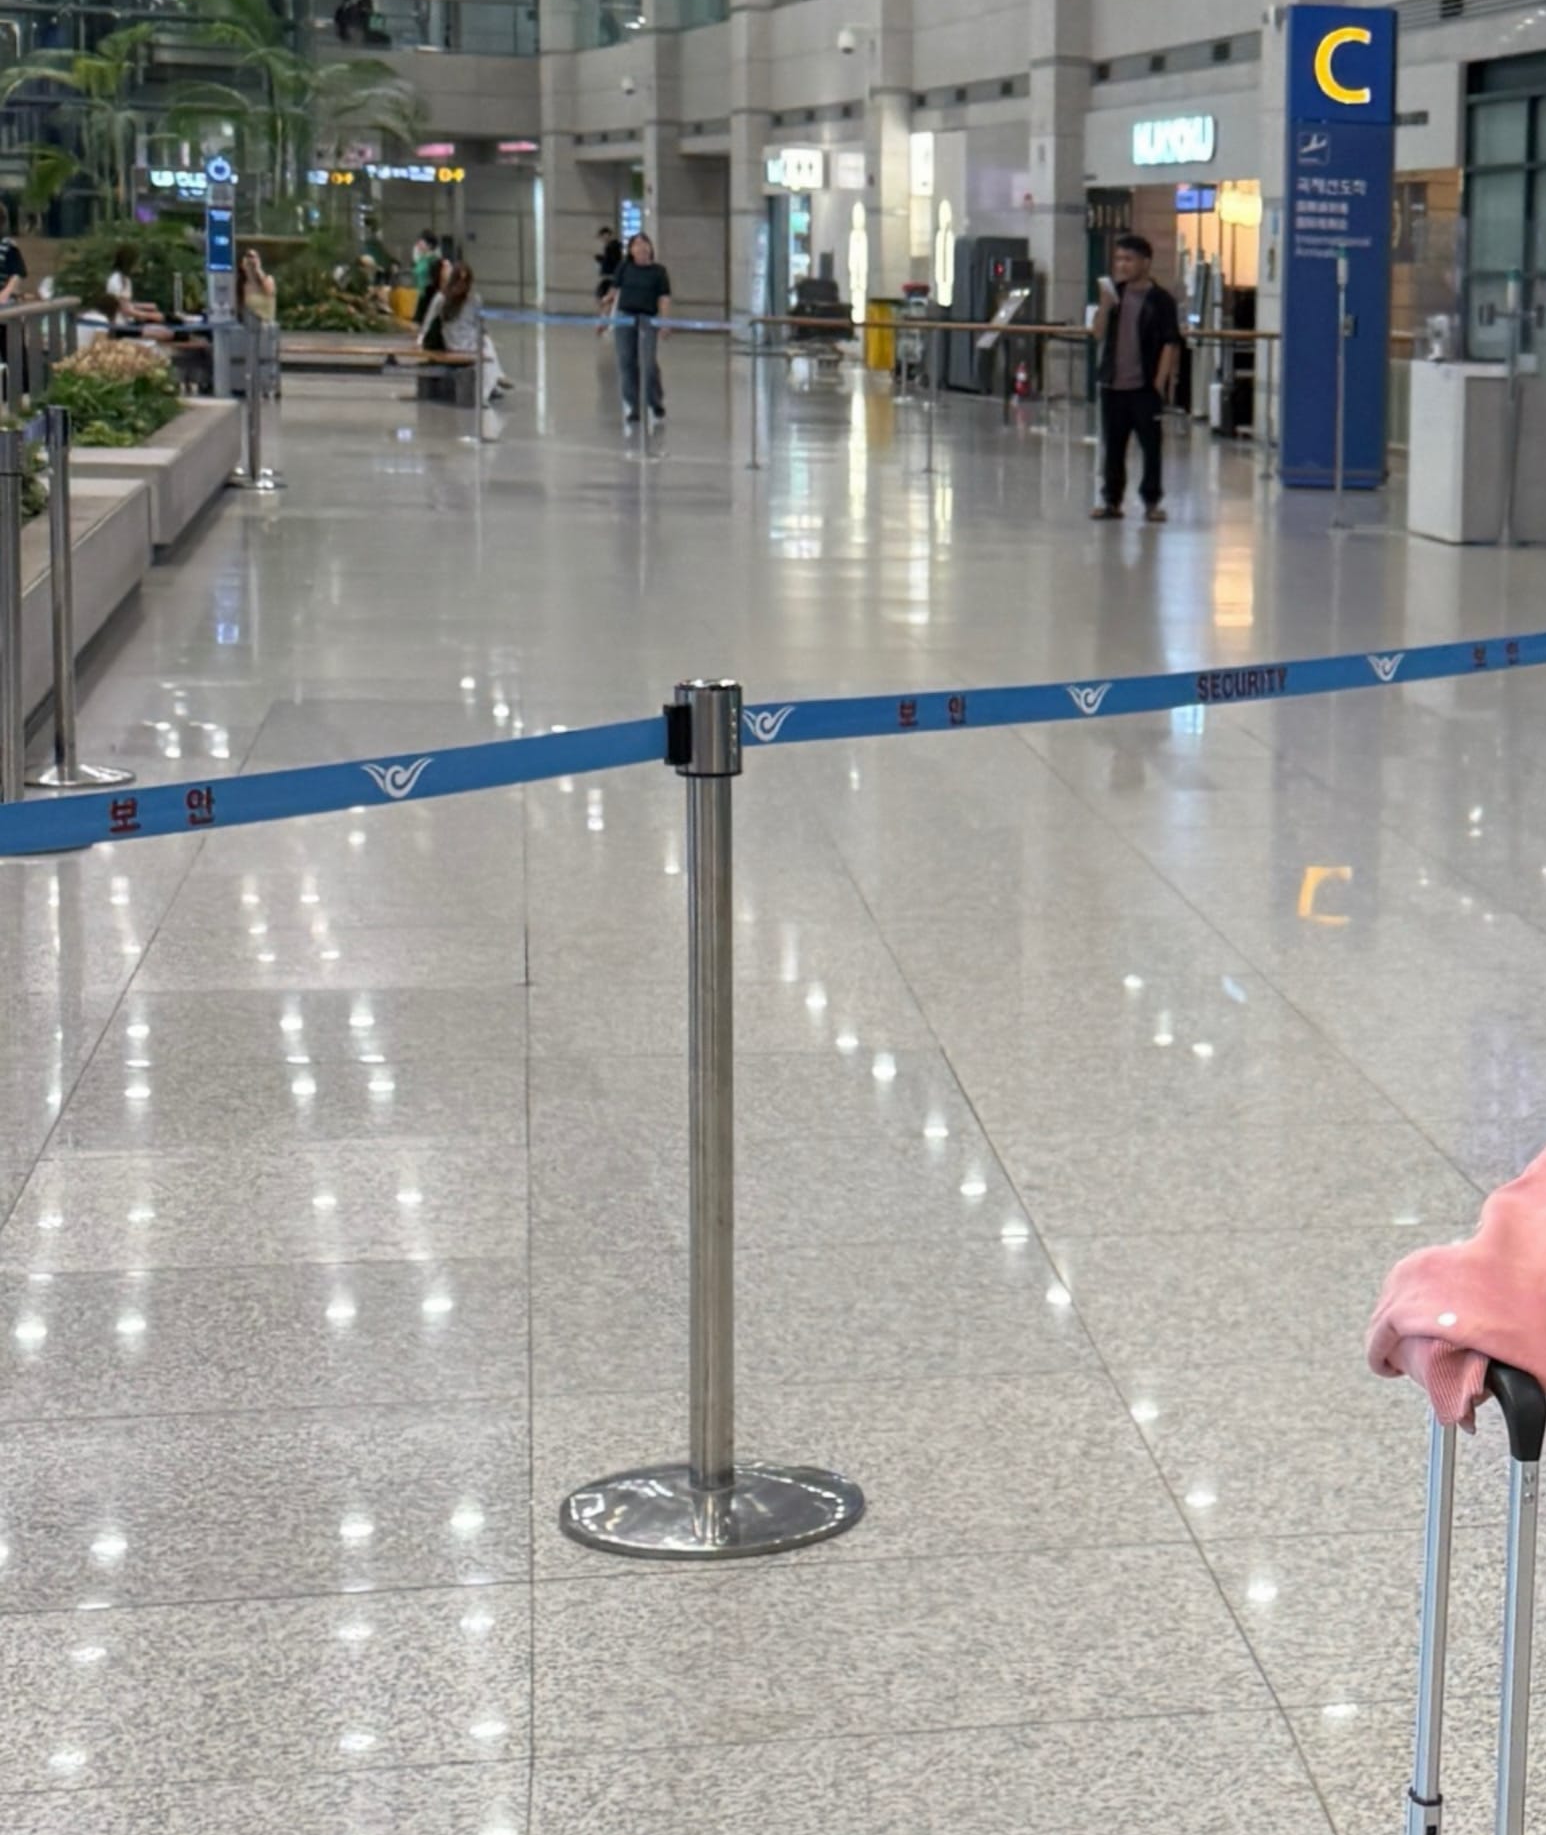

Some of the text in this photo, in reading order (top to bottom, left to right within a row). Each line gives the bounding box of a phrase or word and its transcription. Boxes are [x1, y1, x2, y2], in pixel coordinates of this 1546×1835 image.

[1314, 26, 1372, 105] C
[1197, 666, 1287, 701] SECURITY
[109, 787, 214, 833] 보 안
